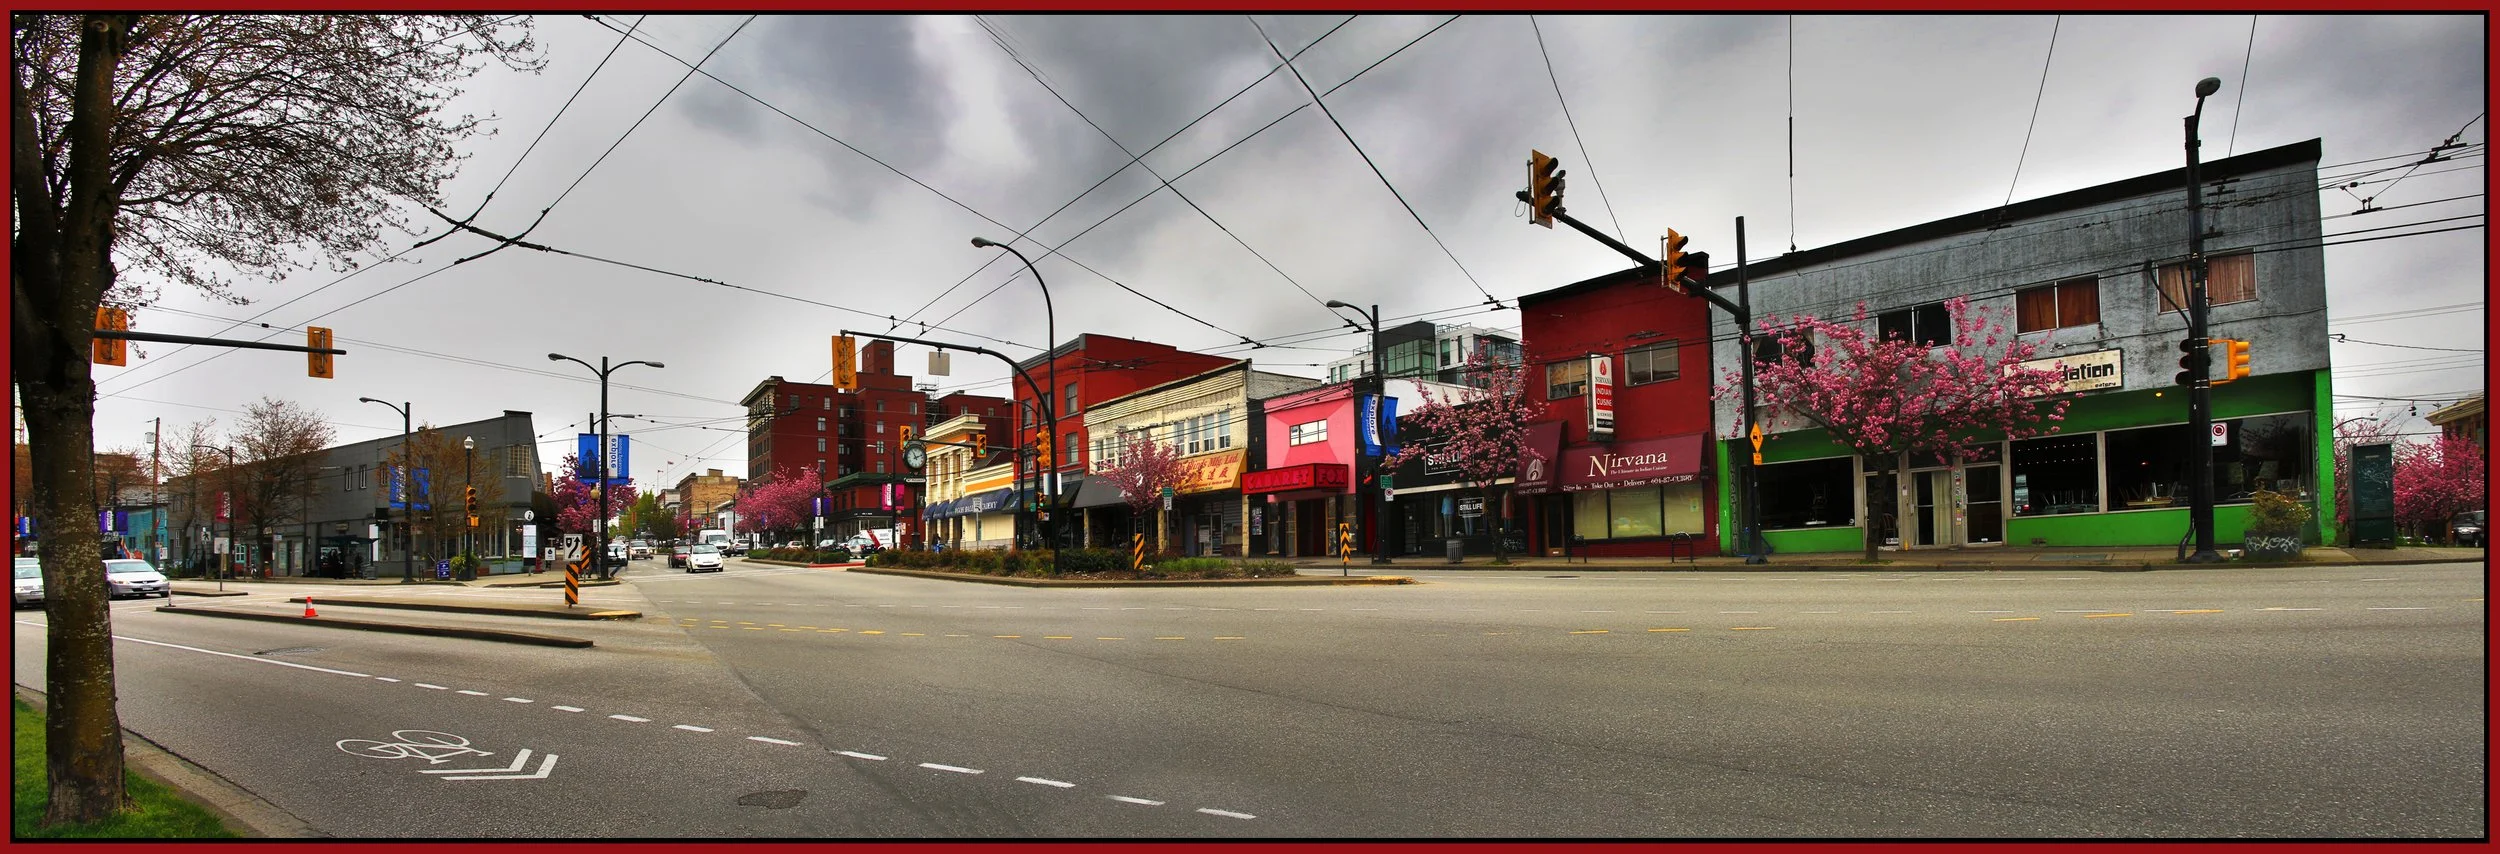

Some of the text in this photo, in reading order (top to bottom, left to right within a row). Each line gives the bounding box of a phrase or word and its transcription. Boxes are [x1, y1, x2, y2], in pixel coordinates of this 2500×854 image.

[1596, 387, 1612, 395] INDIAN
[1597, 398, 1612, 406] CUISINE
[1369, 400, 1377, 434] explore
[1587, 452, 1667, 477] Nirvana
[1247, 468, 1309, 491] CABARET
[1317, 468, 1345, 485] FOX
